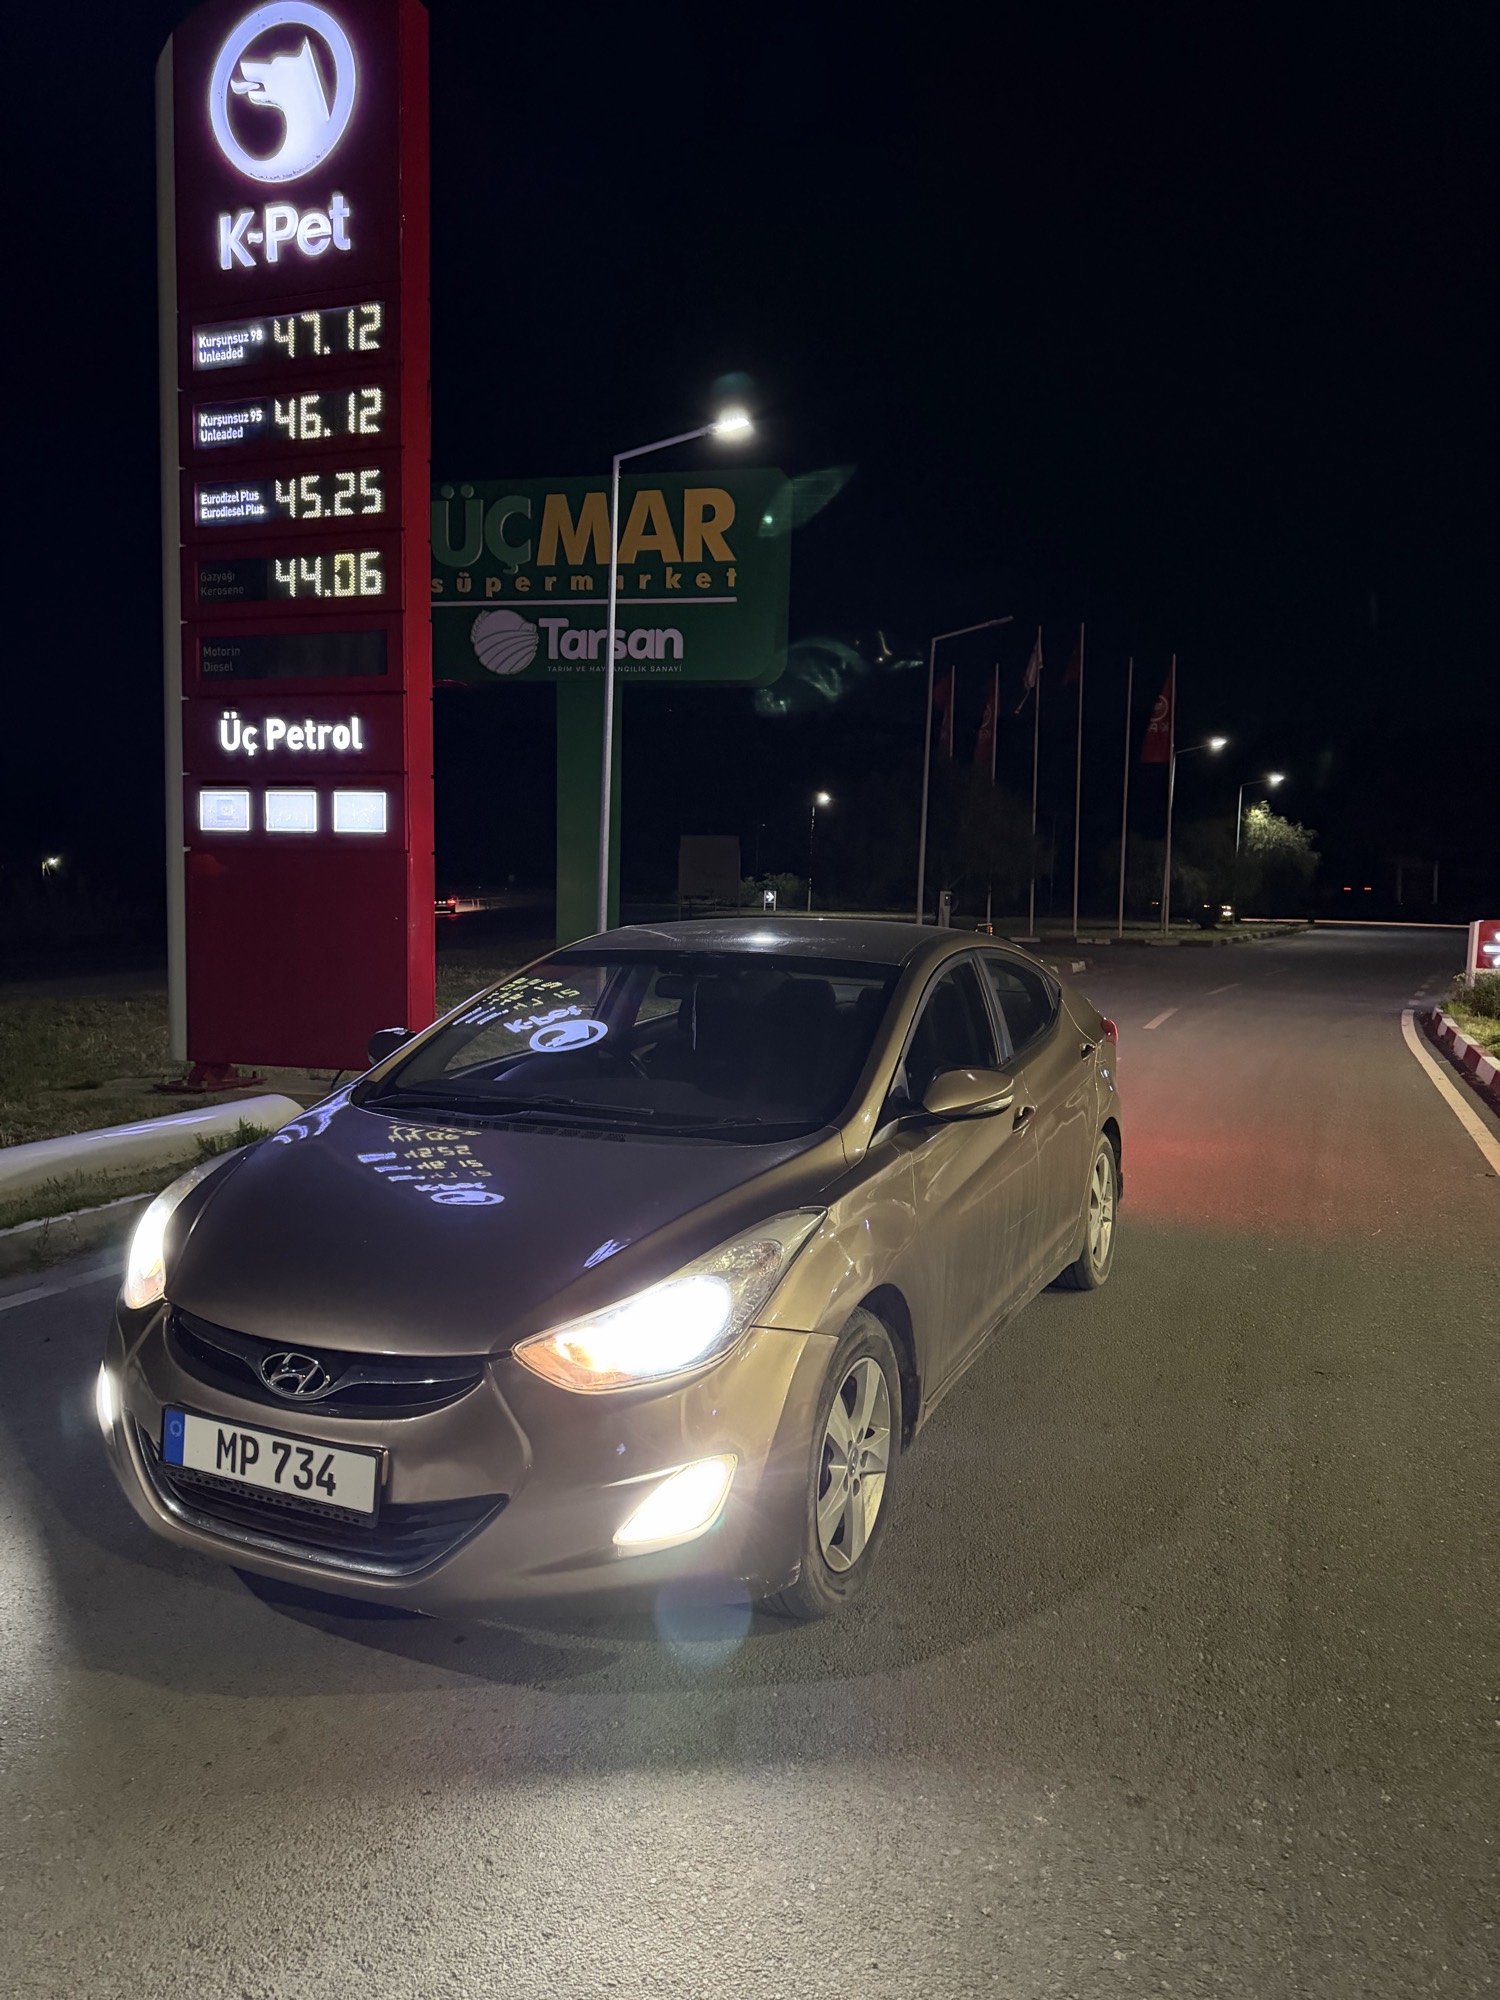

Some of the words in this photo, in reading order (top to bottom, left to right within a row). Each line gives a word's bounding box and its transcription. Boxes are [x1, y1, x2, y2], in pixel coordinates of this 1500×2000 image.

[219, 194, 352, 271] K-Pet
[199, 332, 249, 350] Kurşunsuz
[250, 329, 263, 343] 98
[273, 303, 382, 358] 47.12
[199, 346, 244, 364] Unleaded
[200, 412, 249, 430] Kurşunsuz
[250, 410, 263, 424] 95
[273, 387, 383, 440] 46.12
[200, 427, 244, 443] Unleaded
[201, 492, 240, 505] Eurodizel
[240, 491, 260, 502] Plus
[274, 469, 383, 519] 45.25
[201, 506, 246, 519] Eurodiesel
[246, 503, 265, 516] Plus
[200, 569, 236, 584] Gazyağı
[274, 551, 383, 598] 44.06
[201, 585, 245, 598] Kerosene
[538, 617, 684, 660] Tarsan
[203, 645, 241, 657] Motorin
[203, 660, 234, 672] Diesel
[547, 665, 573, 673] TARIM
[575, 665, 586, 673] VE
[589, 665, 647, 673] HAYANCILIK
[219, 711, 259, 756] Üç
[265, 715, 363, 751] Petrol
[216, 1428, 260, 1476] MP
[271, 1440, 337, 1497] 734
